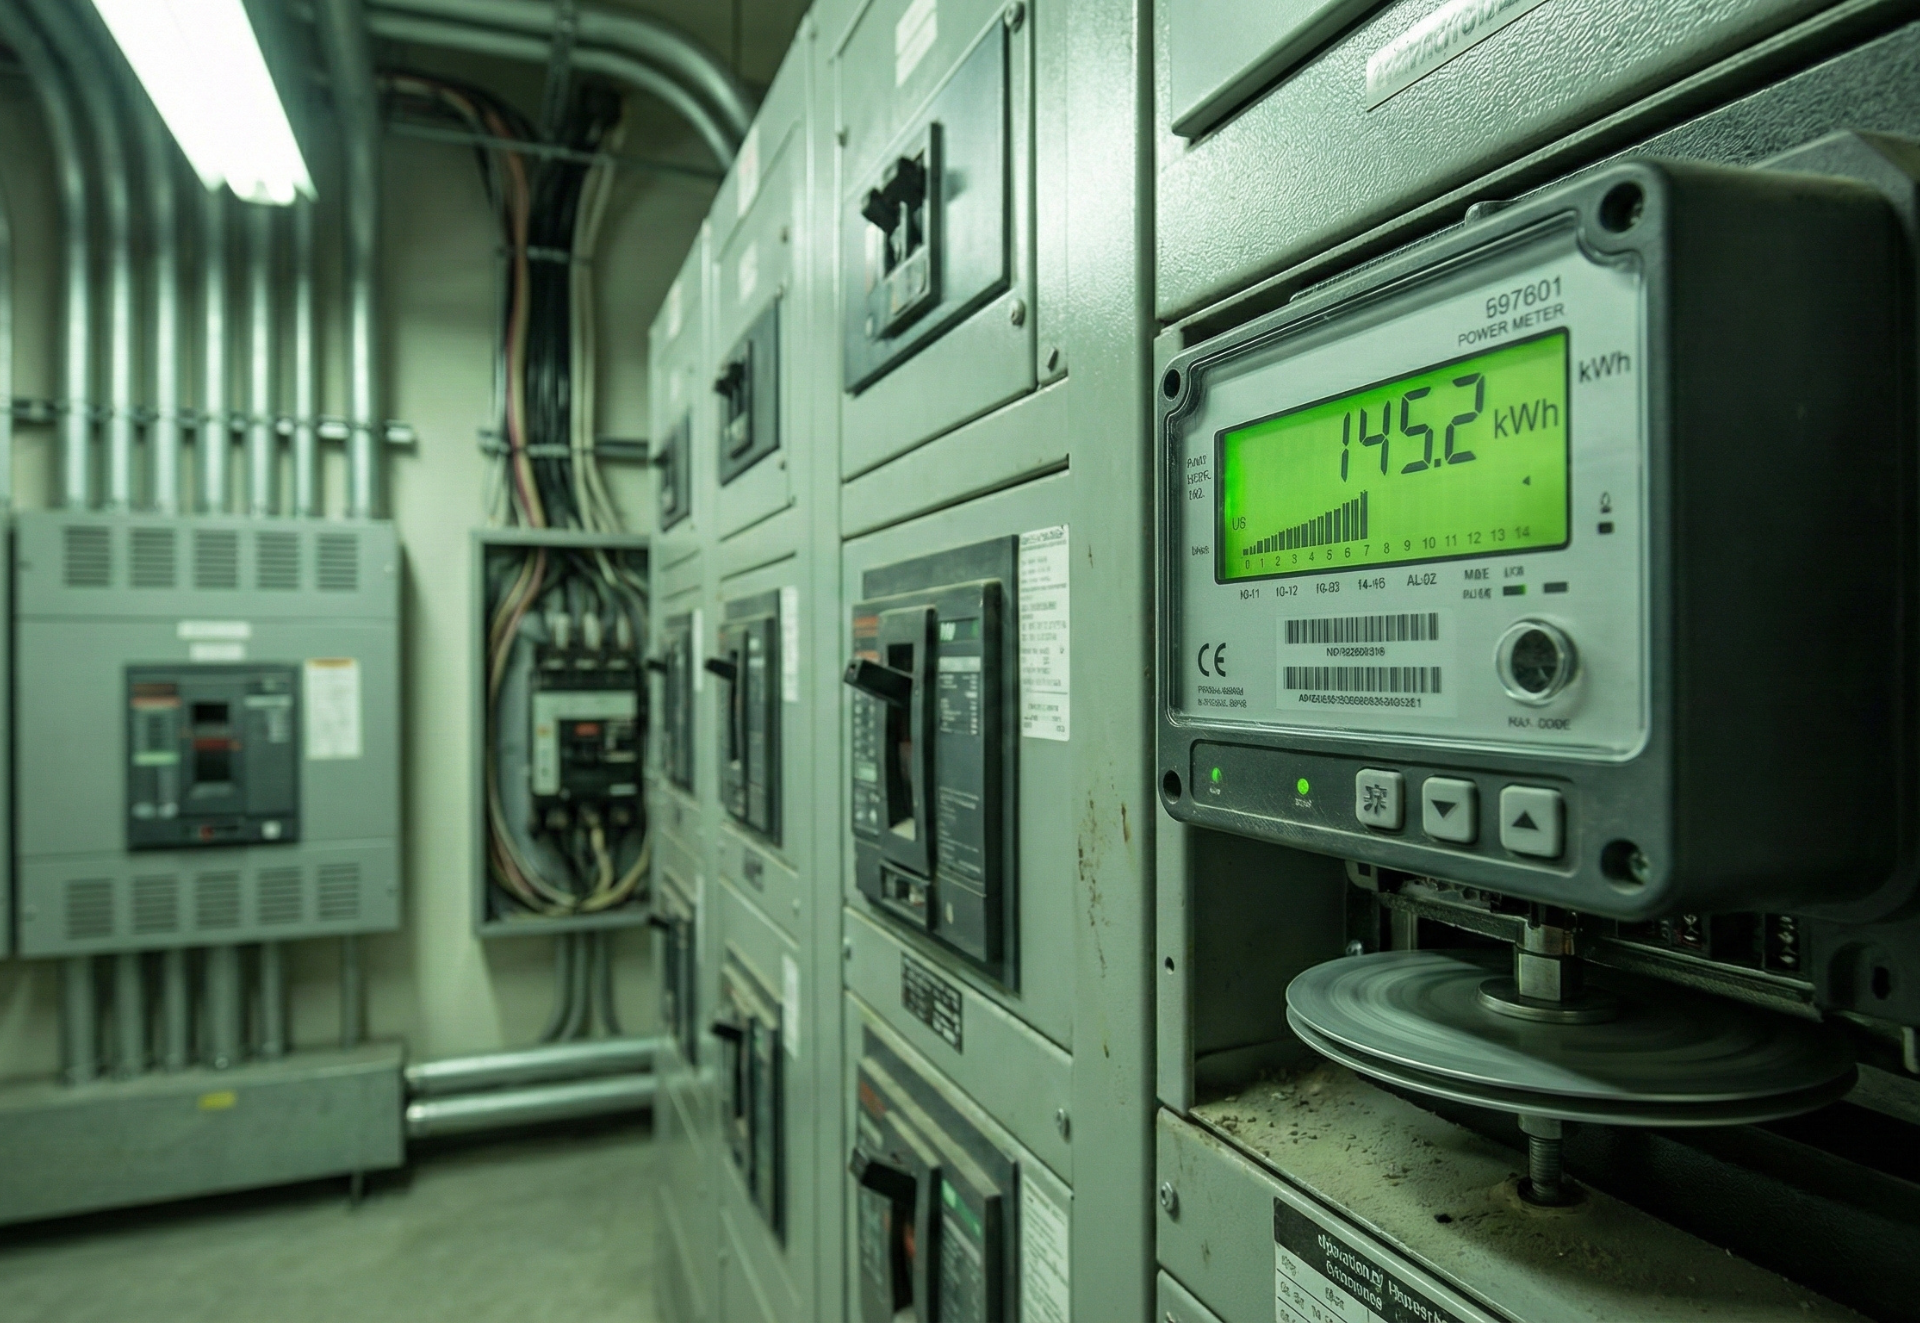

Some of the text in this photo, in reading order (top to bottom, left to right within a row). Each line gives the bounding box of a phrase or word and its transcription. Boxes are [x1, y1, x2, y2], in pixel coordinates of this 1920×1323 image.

[1458, 303, 1565, 347] POWER METER
[1579, 351, 1632, 384] kWh
[1341, 372, 1559, 483] 145.2 kWh
[1275, 556, 1281, 567] 2
[1292, 554, 1298, 564] 3
[1309, 552, 1315, 562] 4
[1344, 547, 1351, 558] 6
[1364, 544, 1370, 556] 7
[1383, 542, 1390, 554] 8
[1404, 540, 1411, 551] 9
[1422, 537, 1436, 550] 10
[1445, 534, 1458, 547] 11
[1467, 532, 1481, 545] 12
[1490, 529, 1505, 542] 13
[1514, 526, 1530, 539] 14
[1198, 642, 1226, 677] CE
